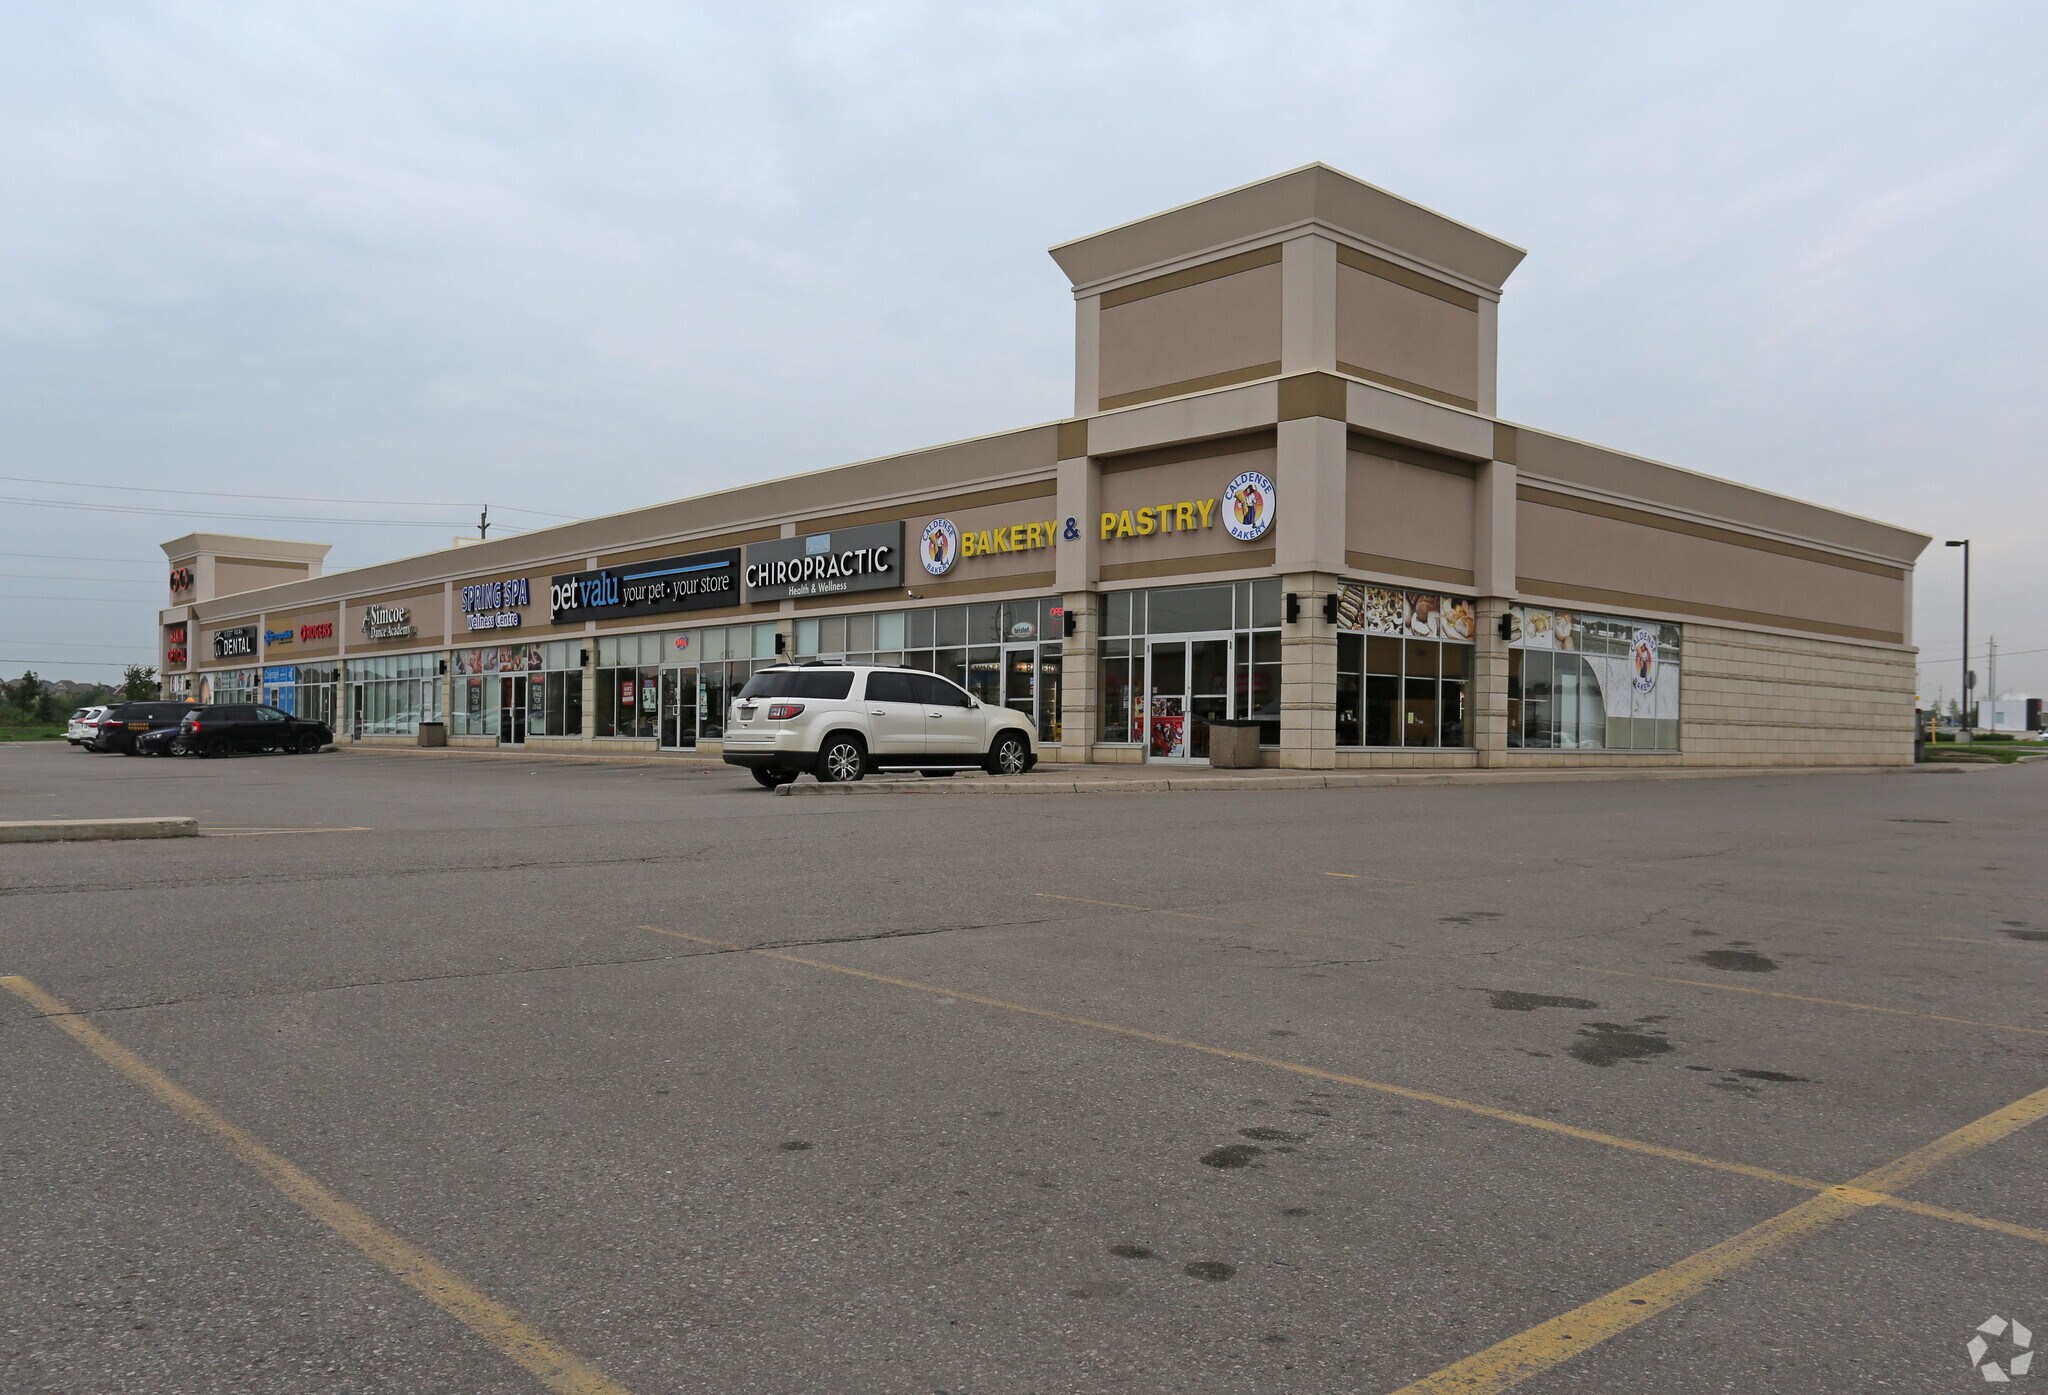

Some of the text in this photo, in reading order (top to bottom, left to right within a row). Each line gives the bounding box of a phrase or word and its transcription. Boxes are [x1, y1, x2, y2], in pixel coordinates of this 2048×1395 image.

[1225, 473, 1272, 501] CALDENSE
[923, 519, 954, 542] CALDENSE
[961, 498, 1215, 557] BAKERY & PASTRY
[1231, 518, 1267, 540] BAKERY
[745, 545, 889, 588] CHIROPRACTIC
[926, 557, 951, 574] BAKERY
[462, 578, 528, 612] SPRING SPA
[550, 571, 618, 619] pet valu
[623, 574, 730, 607] your pet your store
[789, 581, 847, 596] Health & Wellness
[371, 605, 405, 625] Simcoe
[467, 611, 518, 630] Wellness Centre
[306, 622, 333, 639] ROGERS
[371, 624, 411, 639] Dance Academy
[224, 637, 251, 655] DENTAL
[1631, 632, 1656, 654] CALDENSE
